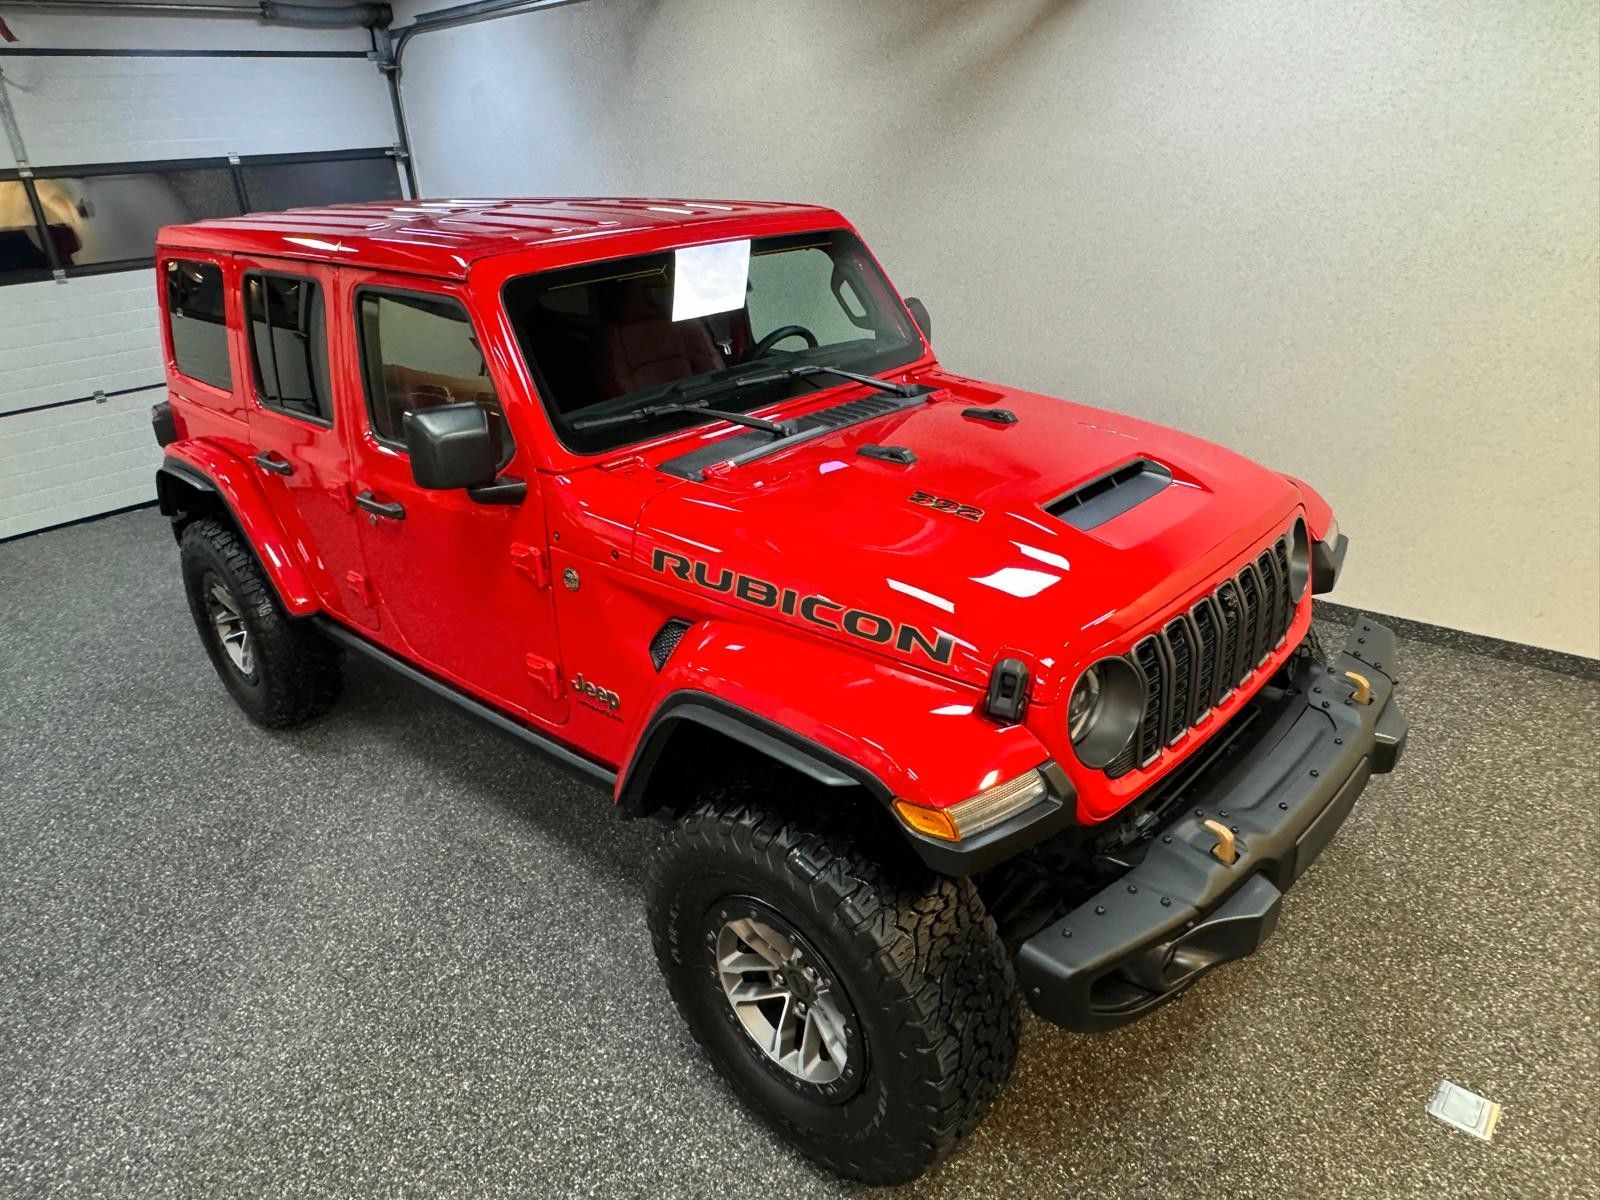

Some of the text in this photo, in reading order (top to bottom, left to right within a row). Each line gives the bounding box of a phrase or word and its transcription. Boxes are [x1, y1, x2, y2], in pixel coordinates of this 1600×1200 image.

[907, 489, 985, 522] 392
[652, 547, 956, 665] RUBICON
[571, 672, 620, 710] Jeep
